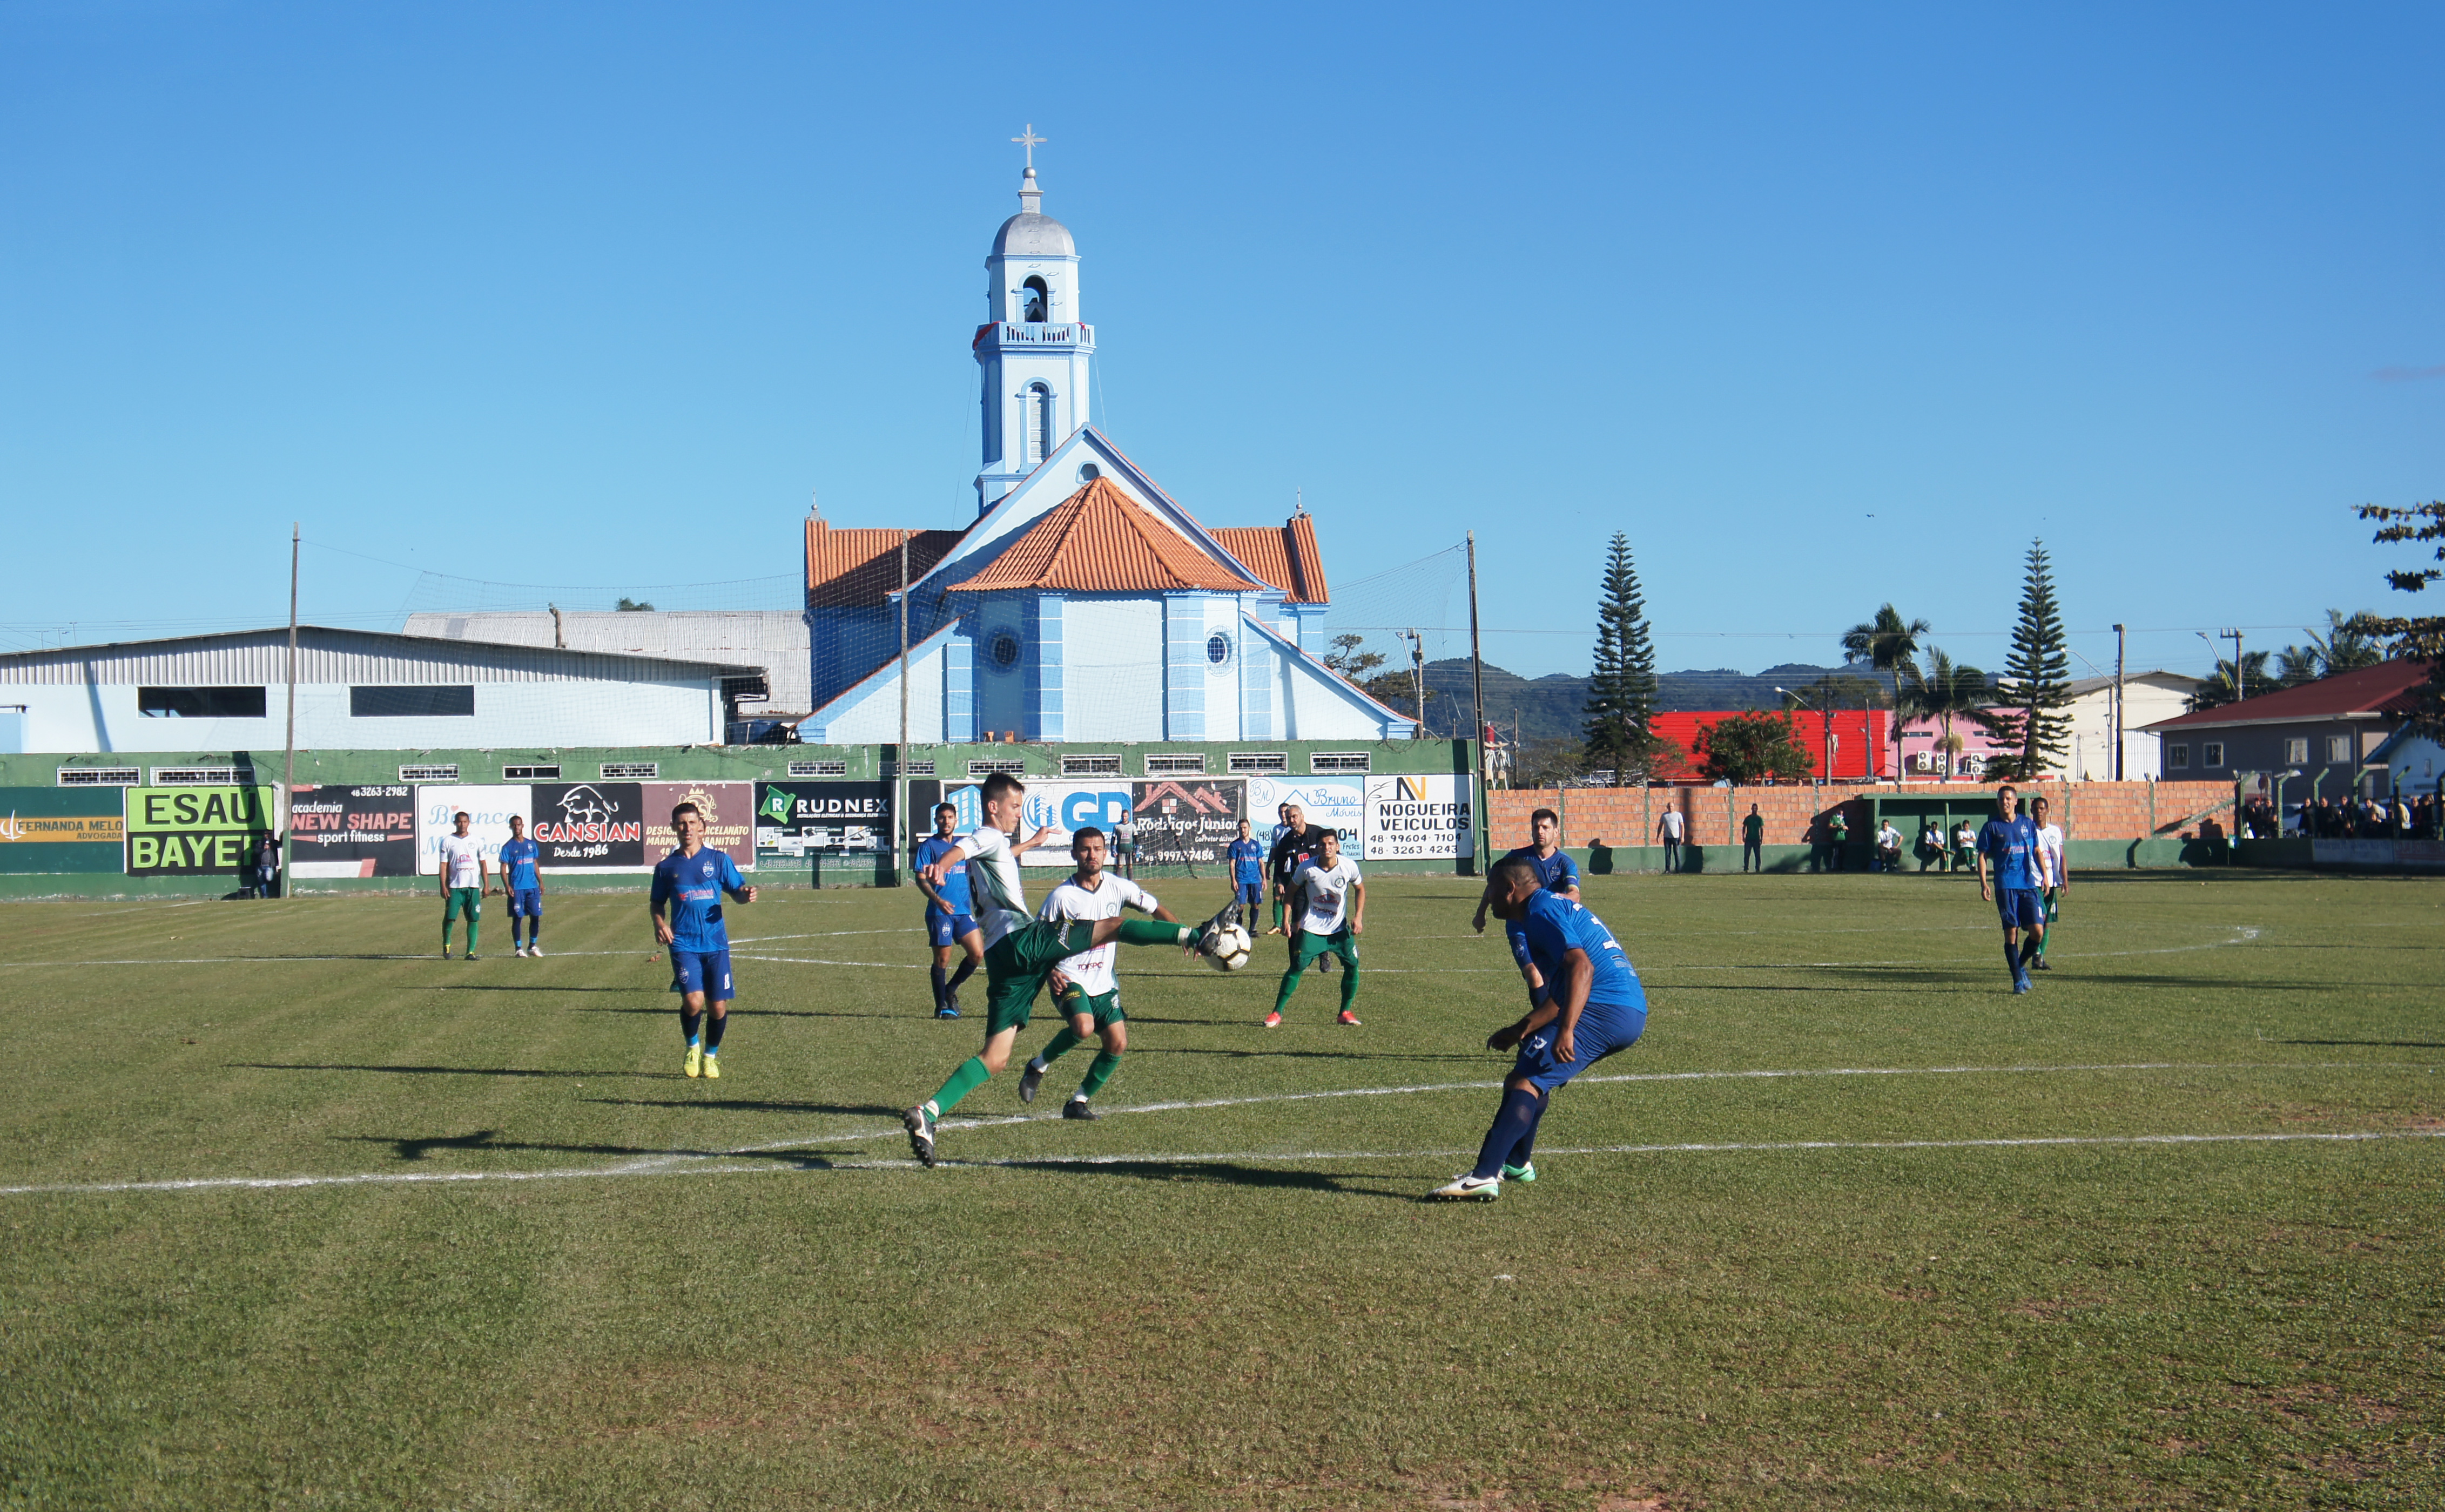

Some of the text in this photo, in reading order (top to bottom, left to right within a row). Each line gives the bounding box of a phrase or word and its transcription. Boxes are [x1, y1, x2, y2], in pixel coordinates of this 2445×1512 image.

[360, 787, 408, 796] 3263-2982
[1314, 788, 1358, 805] Bruno
[292, 801, 342, 813] academia
[772, 798, 784, 812] R
[797, 799, 887, 813] RUDNEX
[1326, 807, 1362, 817] Móveis
[1380, 803, 1470, 816] NOGUEIRA
[291, 813, 412, 831] NEW SHAPE
[428, 805, 518, 825] Binc
[18, 821, 123, 832] FERNANDA MELO
[646, 826, 677, 835] DESIG
[1136, 817, 1238, 836] Rodrigo Junior
[1380, 816, 1469, 831] VEÍCULOS
[318, 829, 385, 847] sport fitness
[534, 822, 641, 842] CANSIAN
[646, 835, 680, 846] MÁRMO
[554, 844, 609, 858] Desde 1986
[1371, 846, 1384, 854] 48
